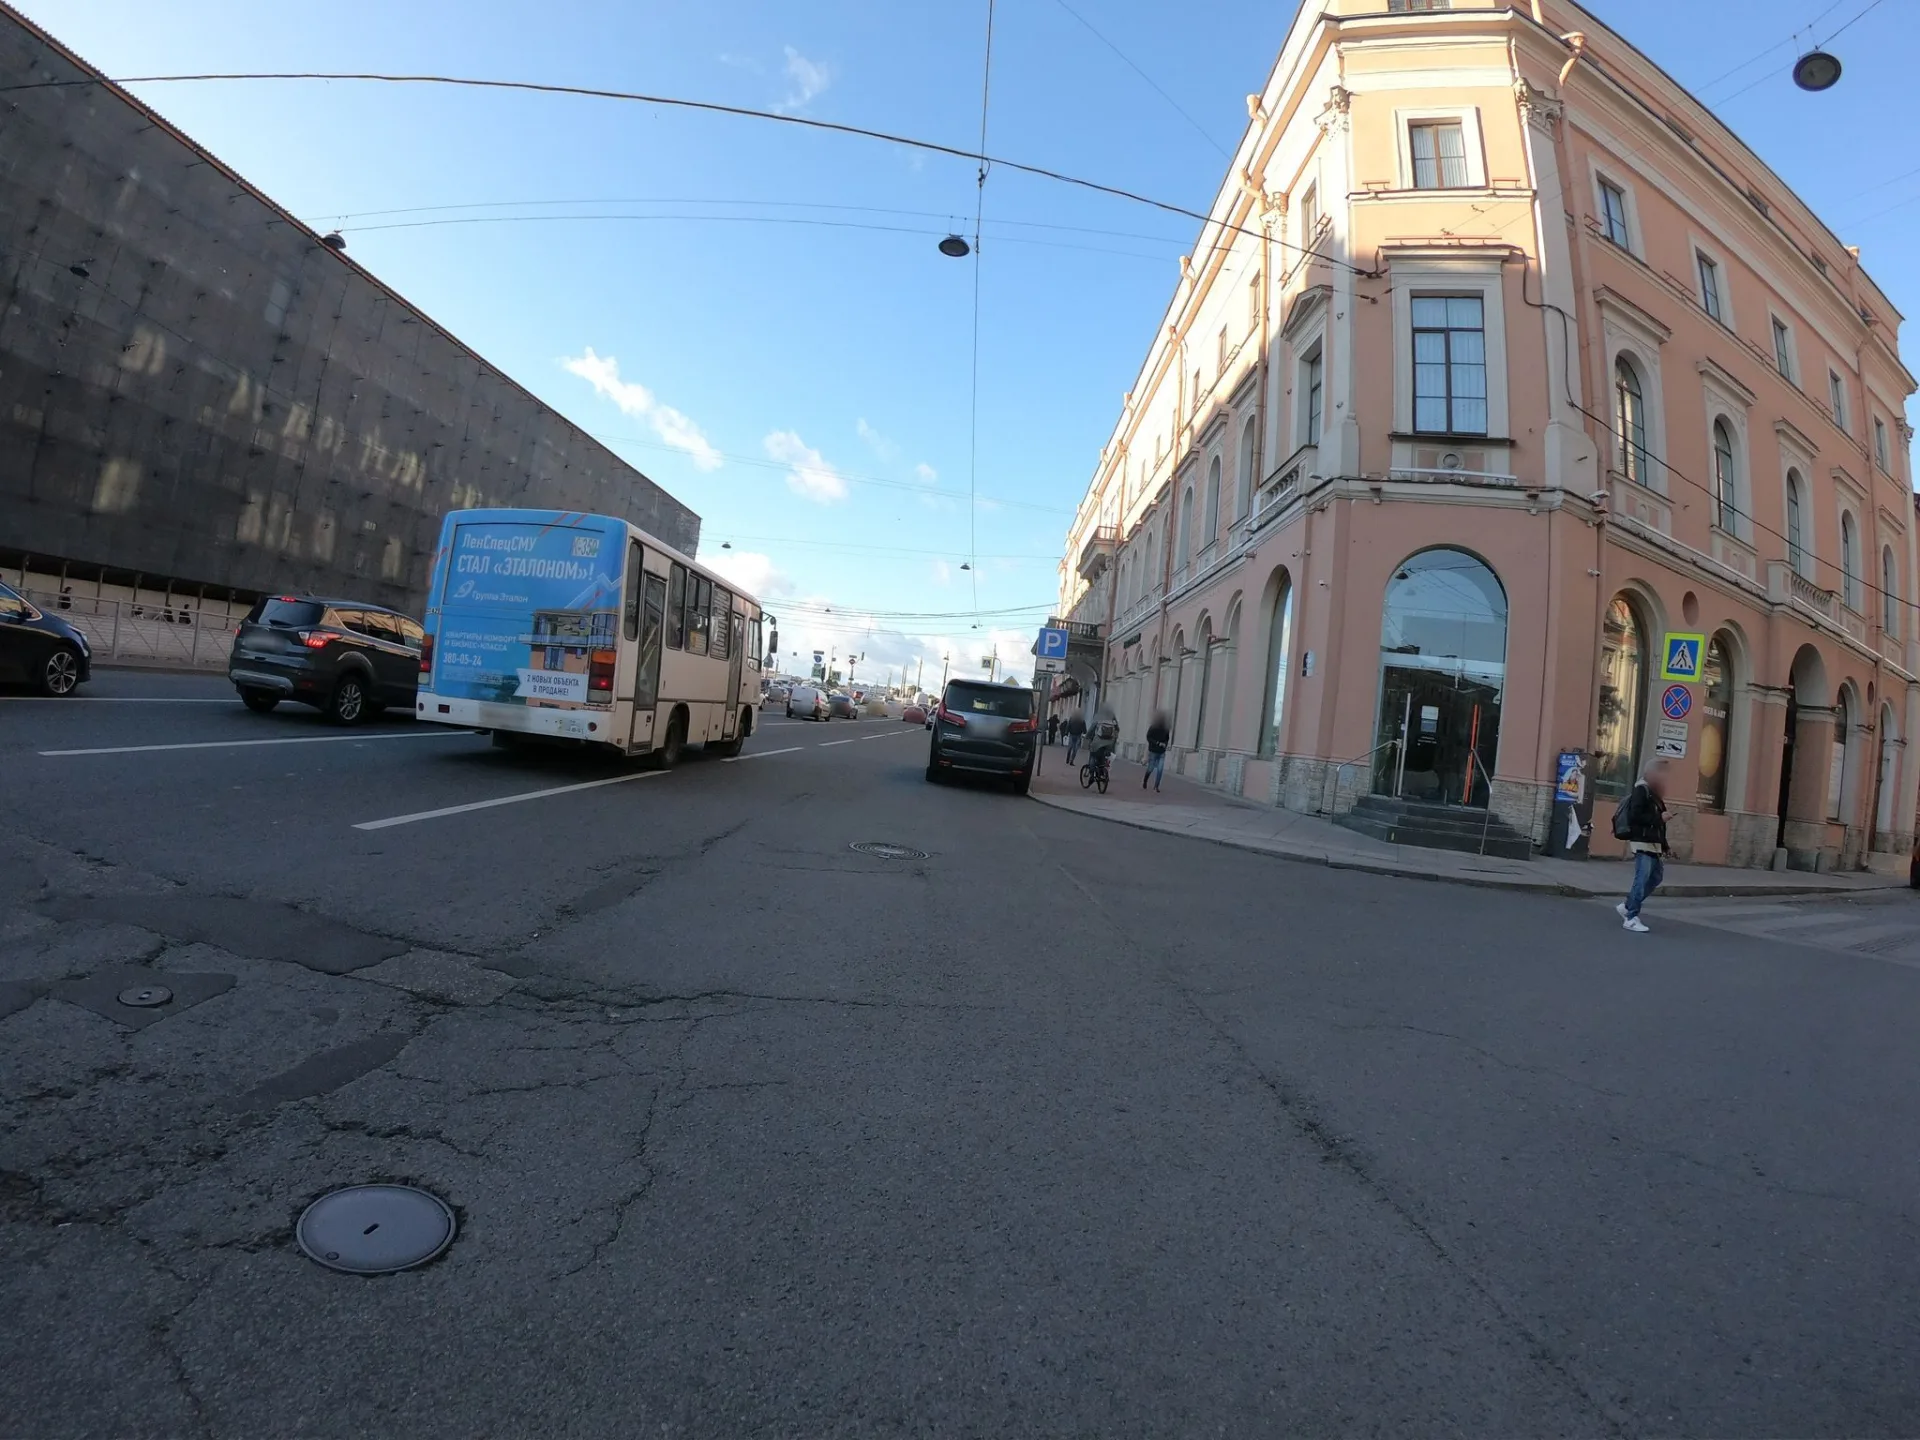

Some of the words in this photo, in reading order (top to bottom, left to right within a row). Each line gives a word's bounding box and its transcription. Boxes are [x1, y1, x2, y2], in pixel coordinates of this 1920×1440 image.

[462, 533, 537, 552] ЛенСпецСМУ
[457, 554, 490, 574] СТАЛ
[494, 557, 595, 581] «ЭТАЛОНОМ»!
[471, 590, 499, 601] Группа
[499, 592, 529, 603] Эталон
[1044, 632, 1061, 655] P
[443, 652, 482, 667] 380-05-24
[527, 675, 531, 683] 2
[532, 675, 552, 684] НОВЫХ
[553, 677, 580, 686] ОБЪЕКТА
[538, 686, 569, 697] ПРОДАЖЕ!
